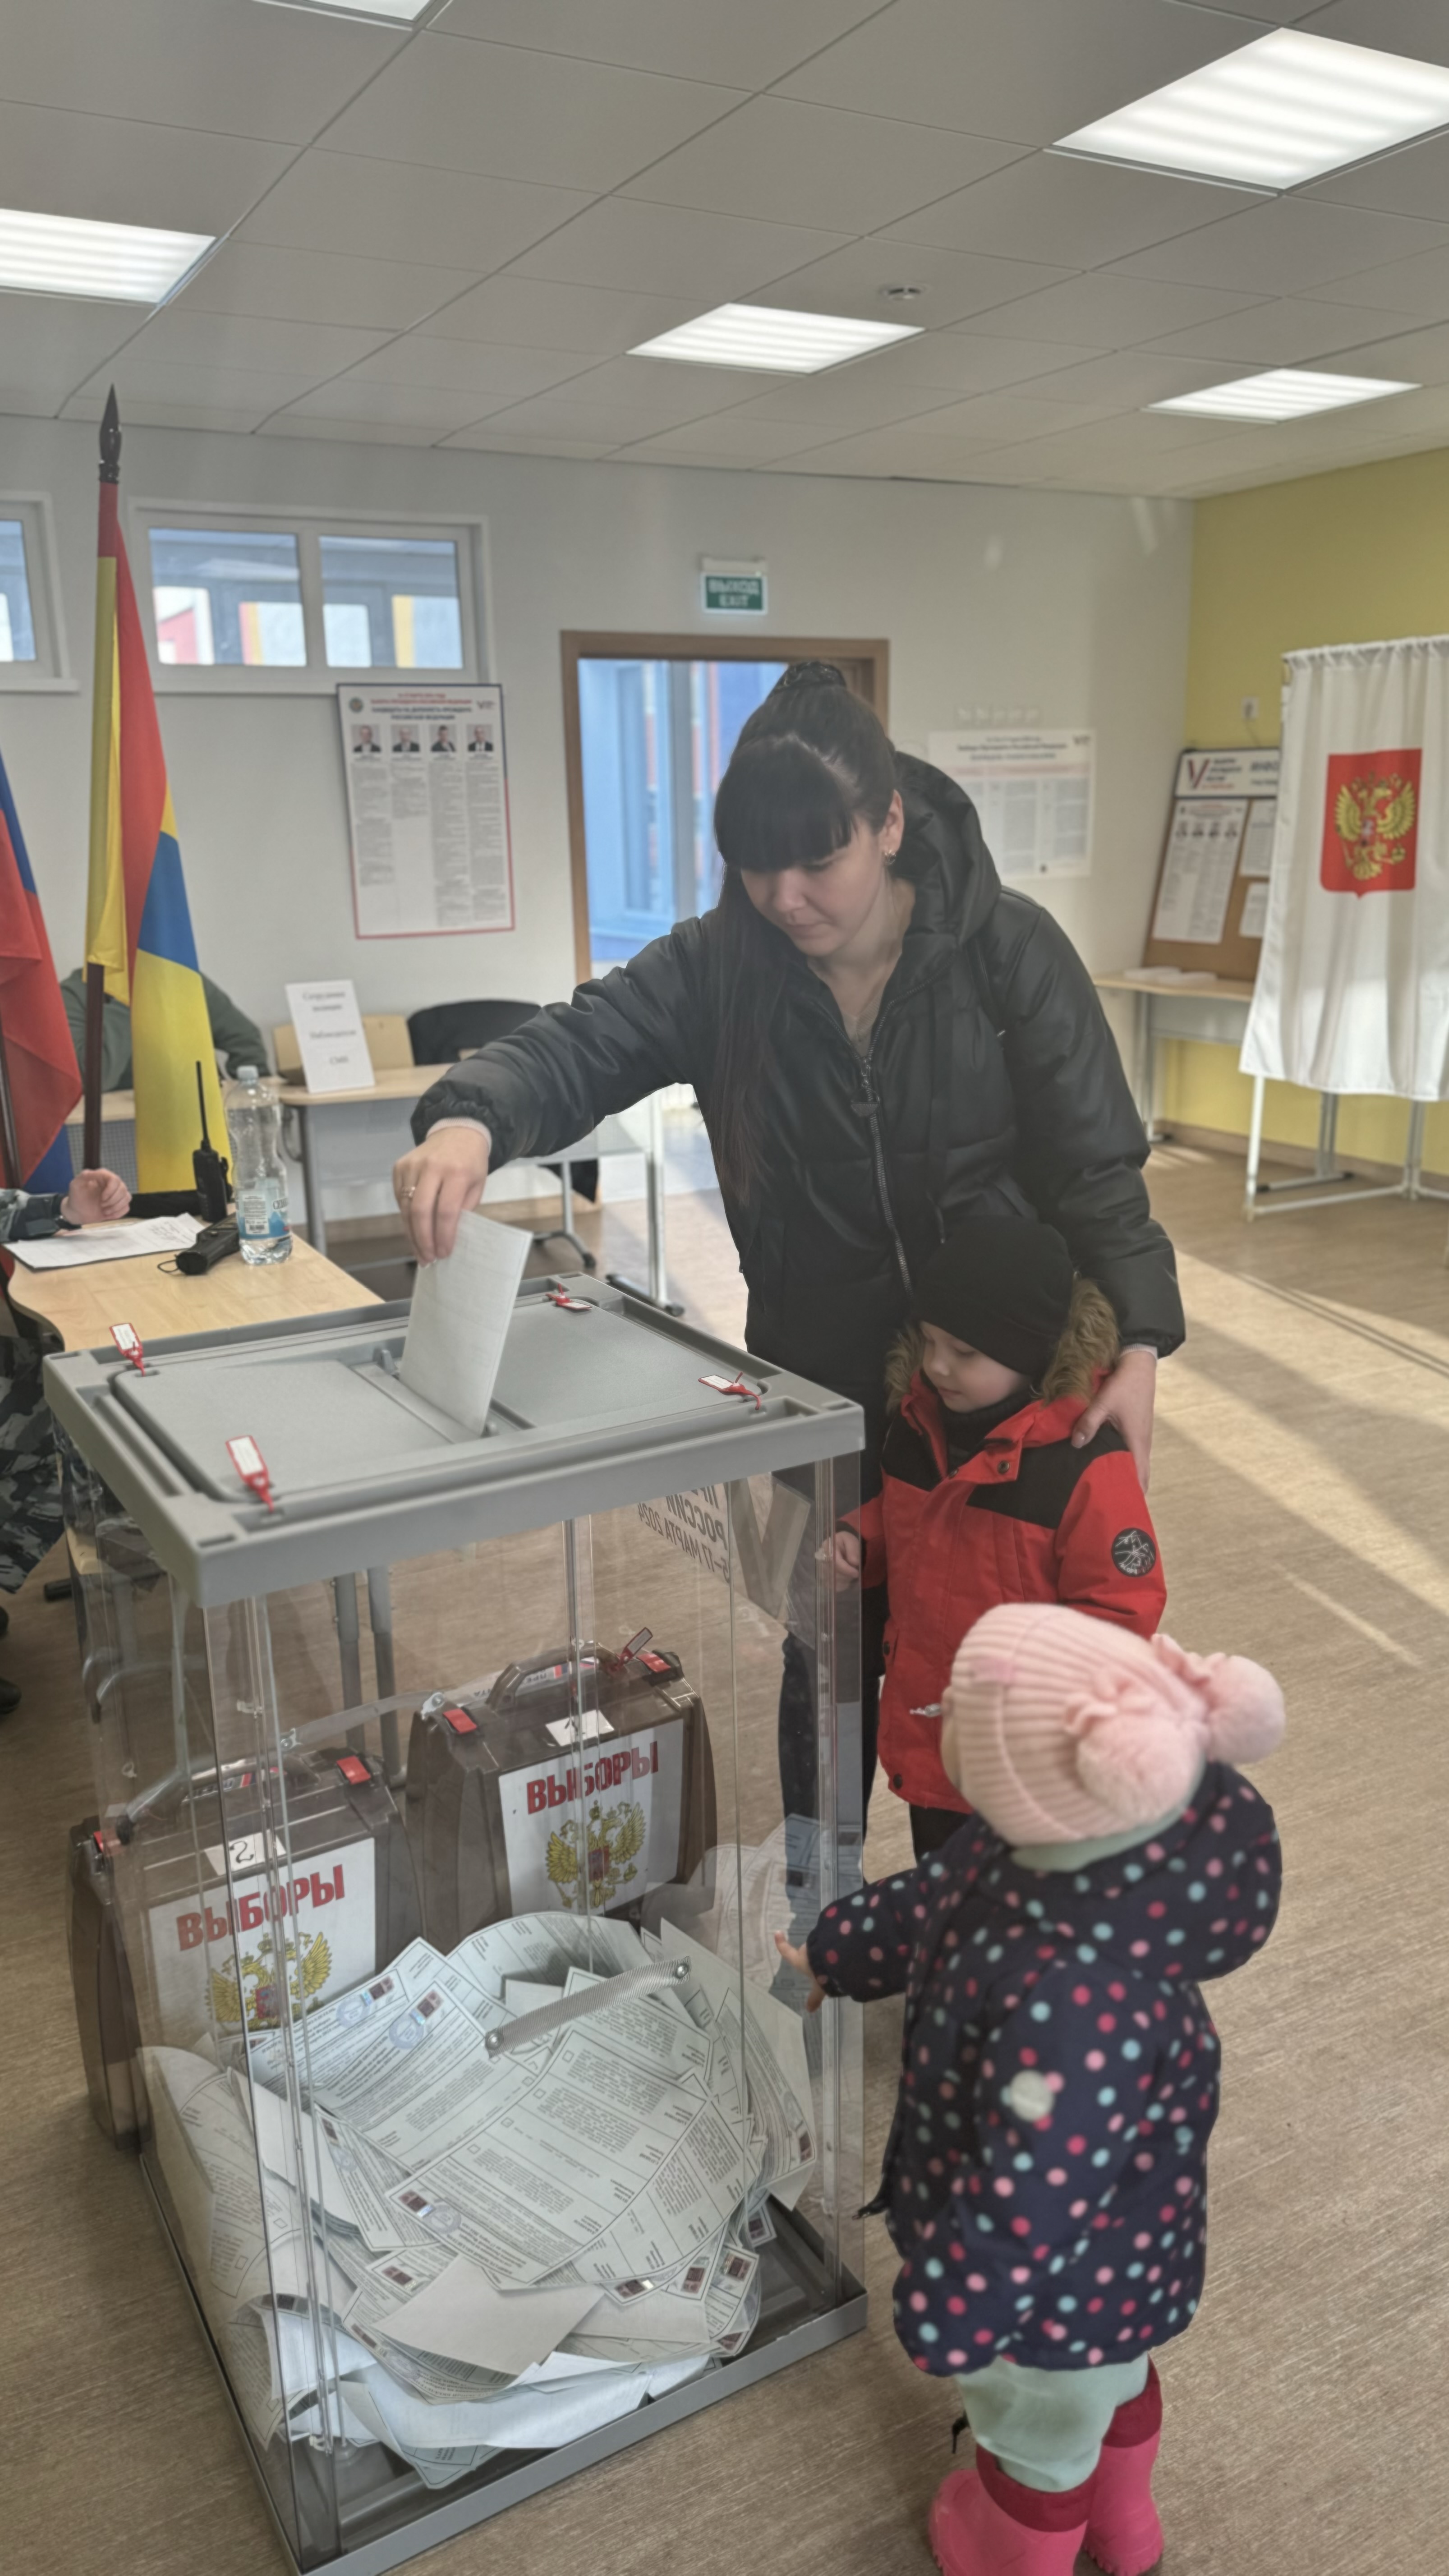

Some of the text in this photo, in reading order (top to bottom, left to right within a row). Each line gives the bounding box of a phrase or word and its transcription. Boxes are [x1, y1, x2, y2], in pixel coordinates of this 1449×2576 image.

[708, 579, 759, 595] ВЫХОД
[719, 594, 749, 607] EXIT
[527, 1741, 658, 1815] ВЫБОРЫ
[176, 1864, 345, 1951] ВЫБОРЫ
